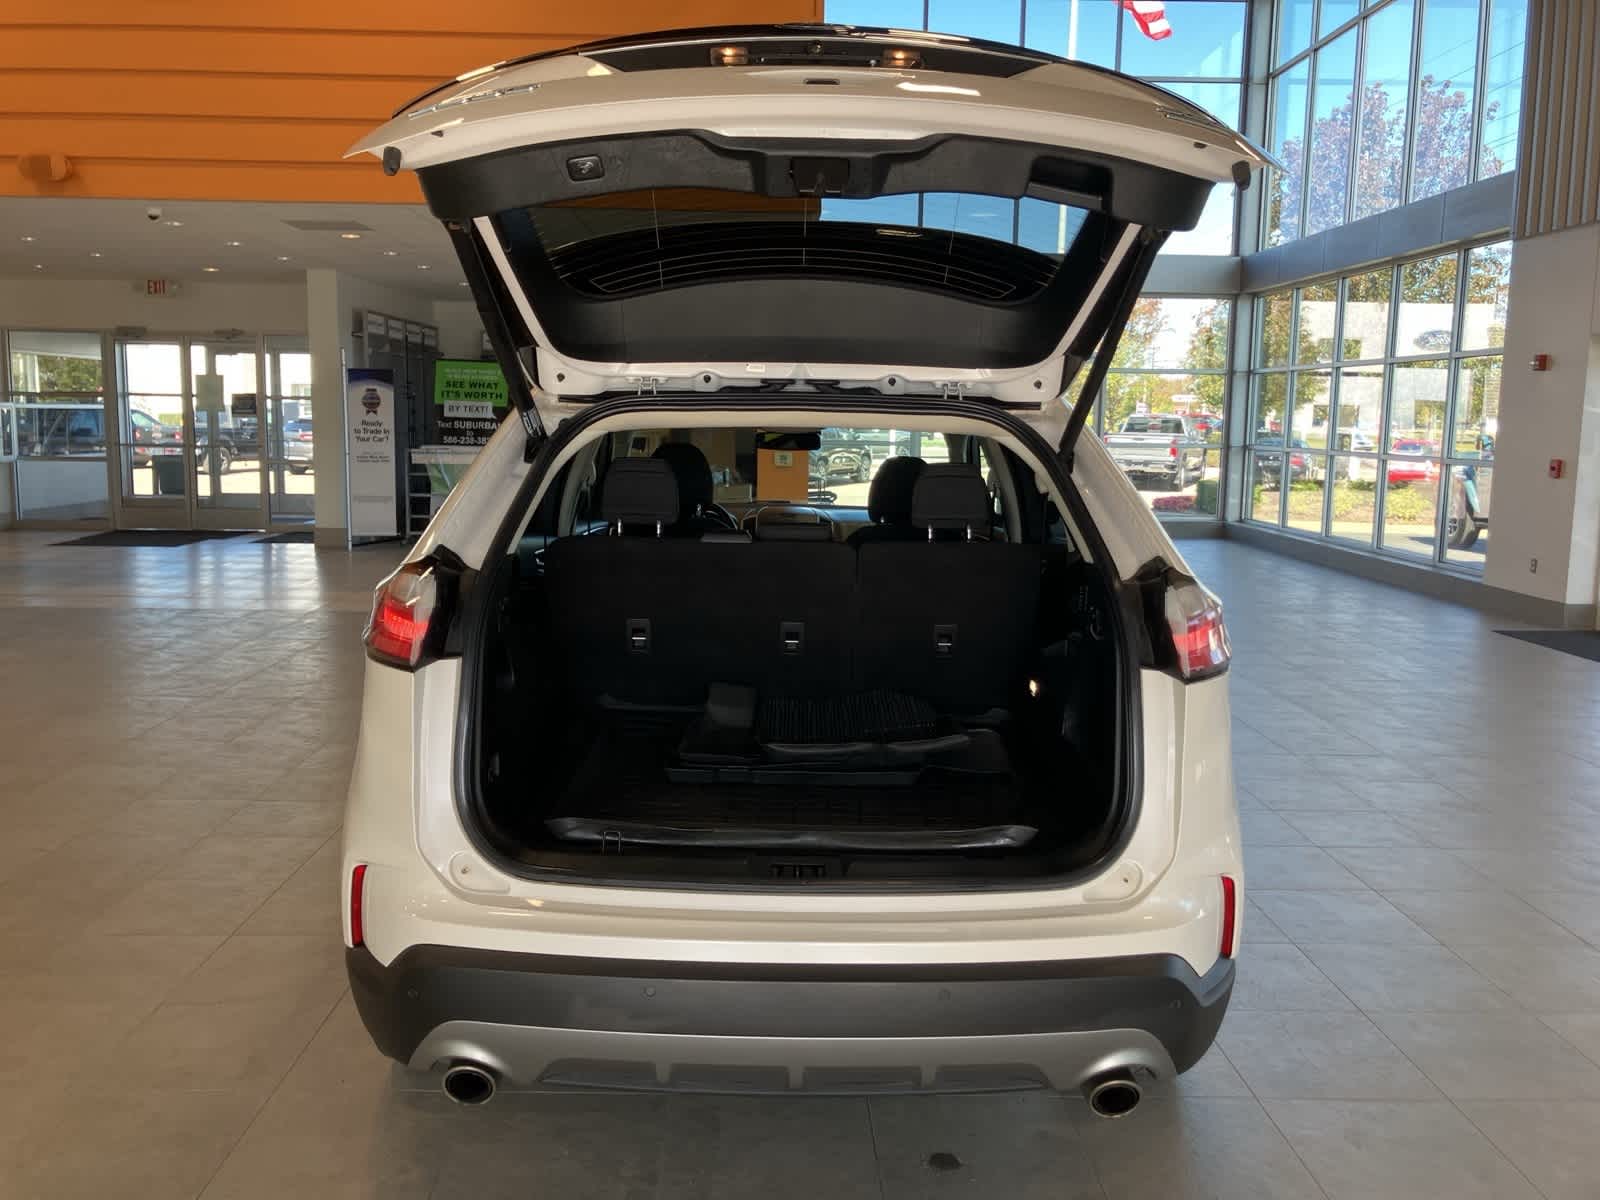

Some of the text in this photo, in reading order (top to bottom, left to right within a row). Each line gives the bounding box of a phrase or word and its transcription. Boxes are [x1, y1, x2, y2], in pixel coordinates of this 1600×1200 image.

[147, 279, 166, 295] EXIT
[445, 381, 499, 390] SEE WHAT
[441, 391, 503, 400] IT'S WORTH
[448, 405, 462, 413] BY
[454, 421, 499, 430] SUBURBA
[363, 427, 381, 435] Trade
